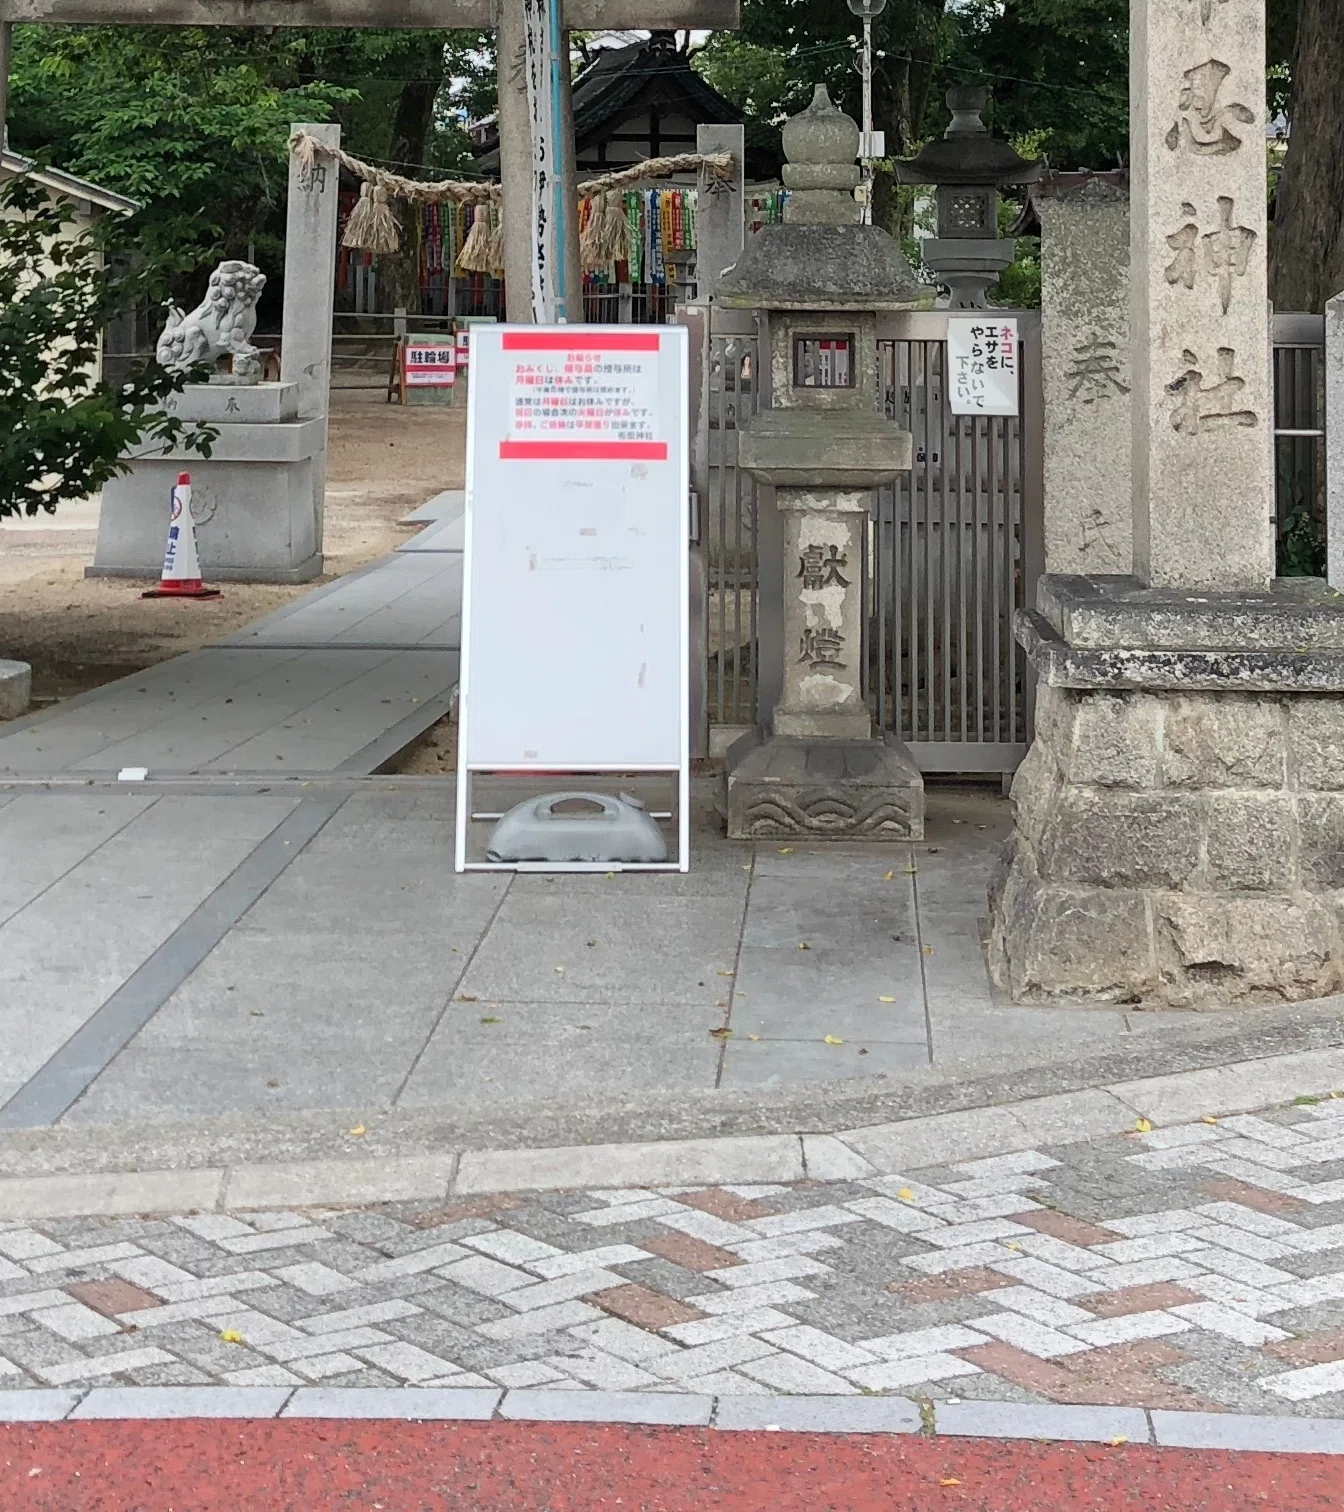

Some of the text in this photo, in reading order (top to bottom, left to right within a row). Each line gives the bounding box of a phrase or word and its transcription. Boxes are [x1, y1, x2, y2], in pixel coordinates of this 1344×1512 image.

[409, 350, 451, 364] 駐輪場
[970, 326, 985, 408] やらないで
[985, 326, 999, 370] エサを
[1000, 325, 1015, 376] ネコに、
[1067, 331, 1132, 405] 奉
[955, 355, 971, 405] 下さい。
